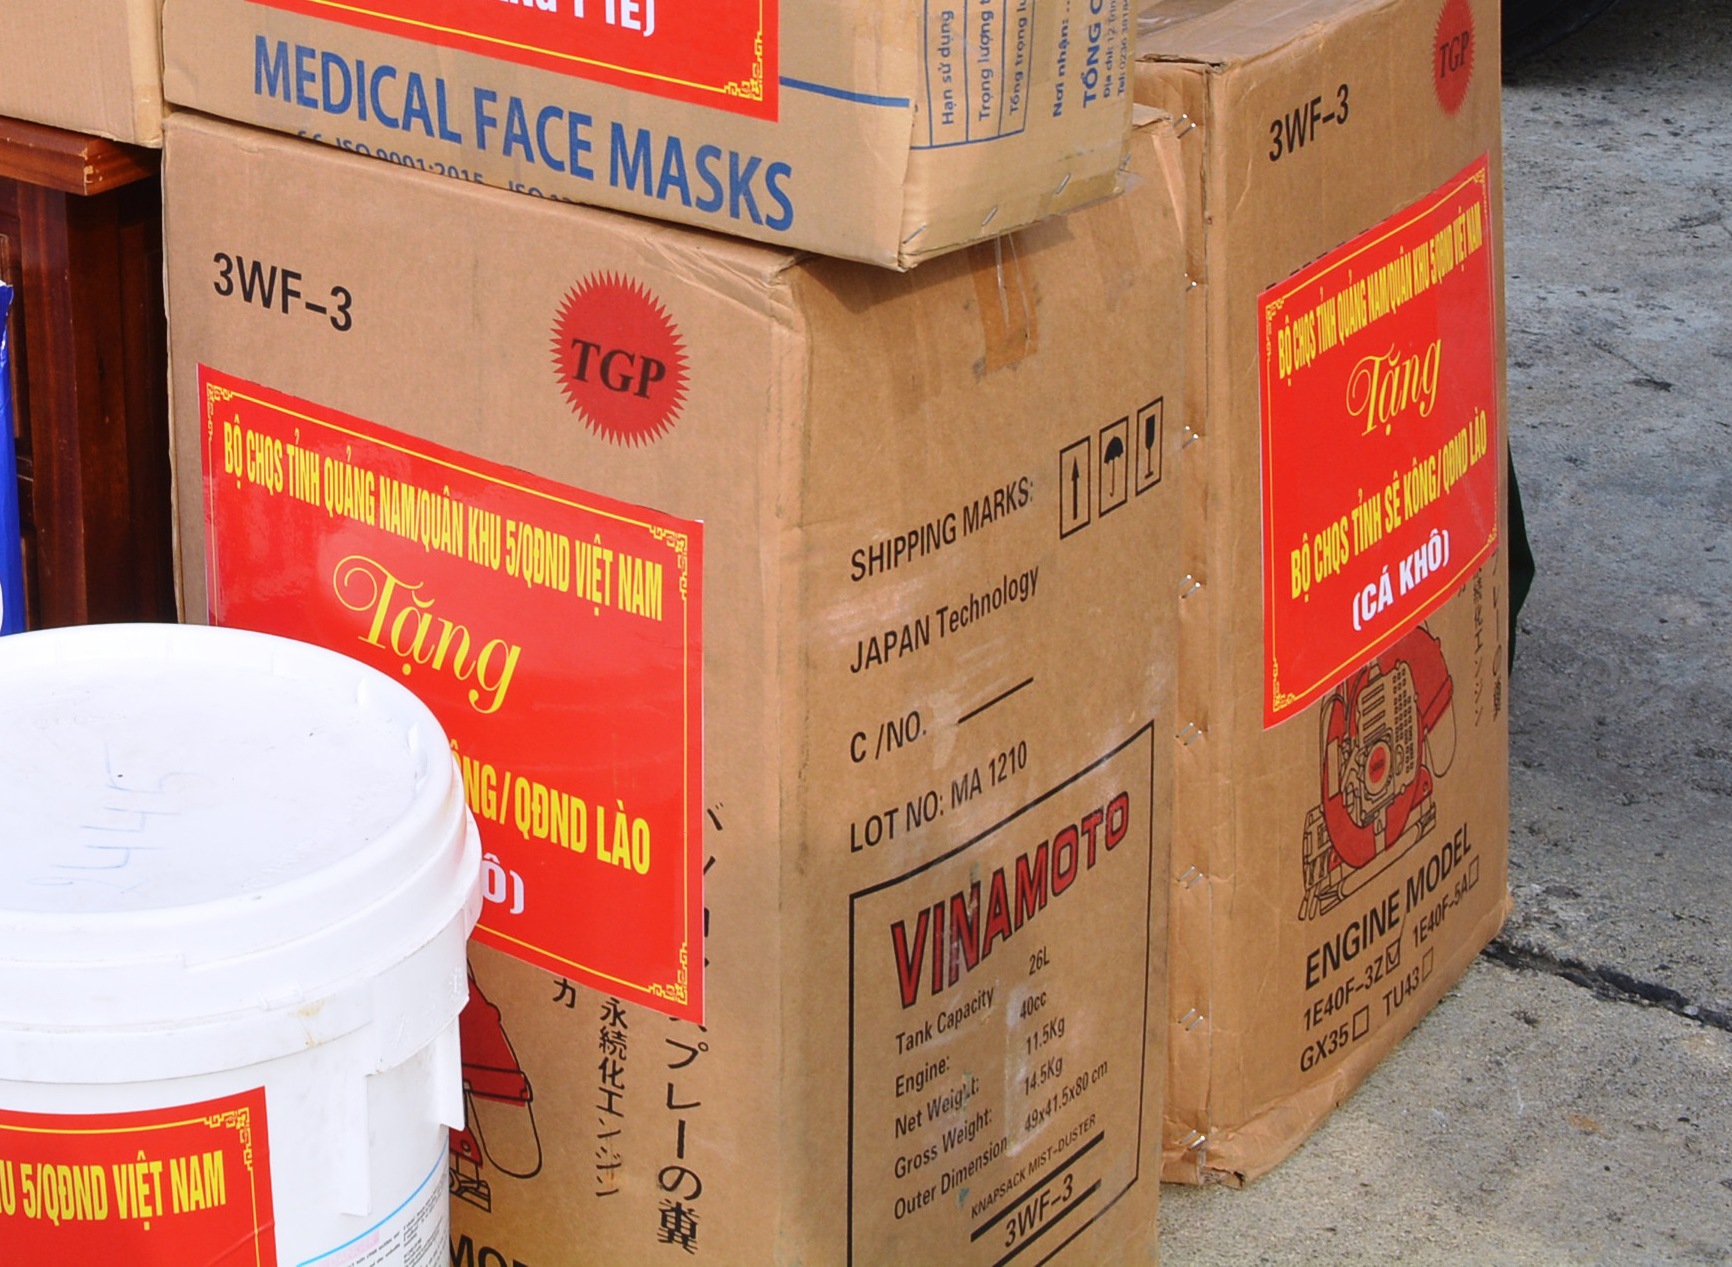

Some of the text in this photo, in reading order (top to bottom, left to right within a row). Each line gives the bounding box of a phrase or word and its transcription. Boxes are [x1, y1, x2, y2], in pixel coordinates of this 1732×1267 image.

[938, 10, 957, 124] Hạn sử dụng
[978, 10, 994, 62] lượng
[1016, 17, 1028, 66] trọng
[1052, 19, 1070, 117] Nơi nhận:
[1081, 22, 1101, 108] TỔNG
[1440, 31, 1469, 78] TGP
[254, 36, 462, 145] MEDICAL
[474, 86, 601, 181] FACE
[610, 129, 795, 233] MASKS
[979, 68, 994, 121] Trọng
[1009, 71, 1024, 115] Tổng
[1269, 84, 1349, 162] 3WF-3
[214, 252, 353, 333] 3WF-3
[571, 338, 666, 400] TGP
[851, 476, 1034, 582] SHIPPING MARKS:
[1352, 529, 1449, 631] (CÁ KHÔ)
[850, 566, 1039, 673] JAPAN Technology
[850, 740, 1027, 853] LOT NO: MA 1210
[891, 791, 1129, 1009] VINAMOTO
[1306, 823, 1471, 990] ENGINE MODEL
[895, 946, 1050, 1055] Tank Capacity 26L
[895, 992, 1047, 1098] Engine: 40cc
[1300, 967, 1419, 1073] GX35 TU43
[1303, 956, 1384, 1031] 1E40F-3Z
[895, 1107, 922, 1139] Net
[1026, 1015, 1065, 1056] 11.5Kg
[895, 1055, 1063, 1180] Gross Weight: 14.5Kg
[894, 1184, 936, 1221] Outer
[940, 1135, 1008, 1194] Dimension
[1091, 1059, 1108, 1084] cm
[971, 1113, 1096, 1219] KNAPSACK MIST-DUSTER
[1005, 1174, 1074, 1248] 3WF-3
